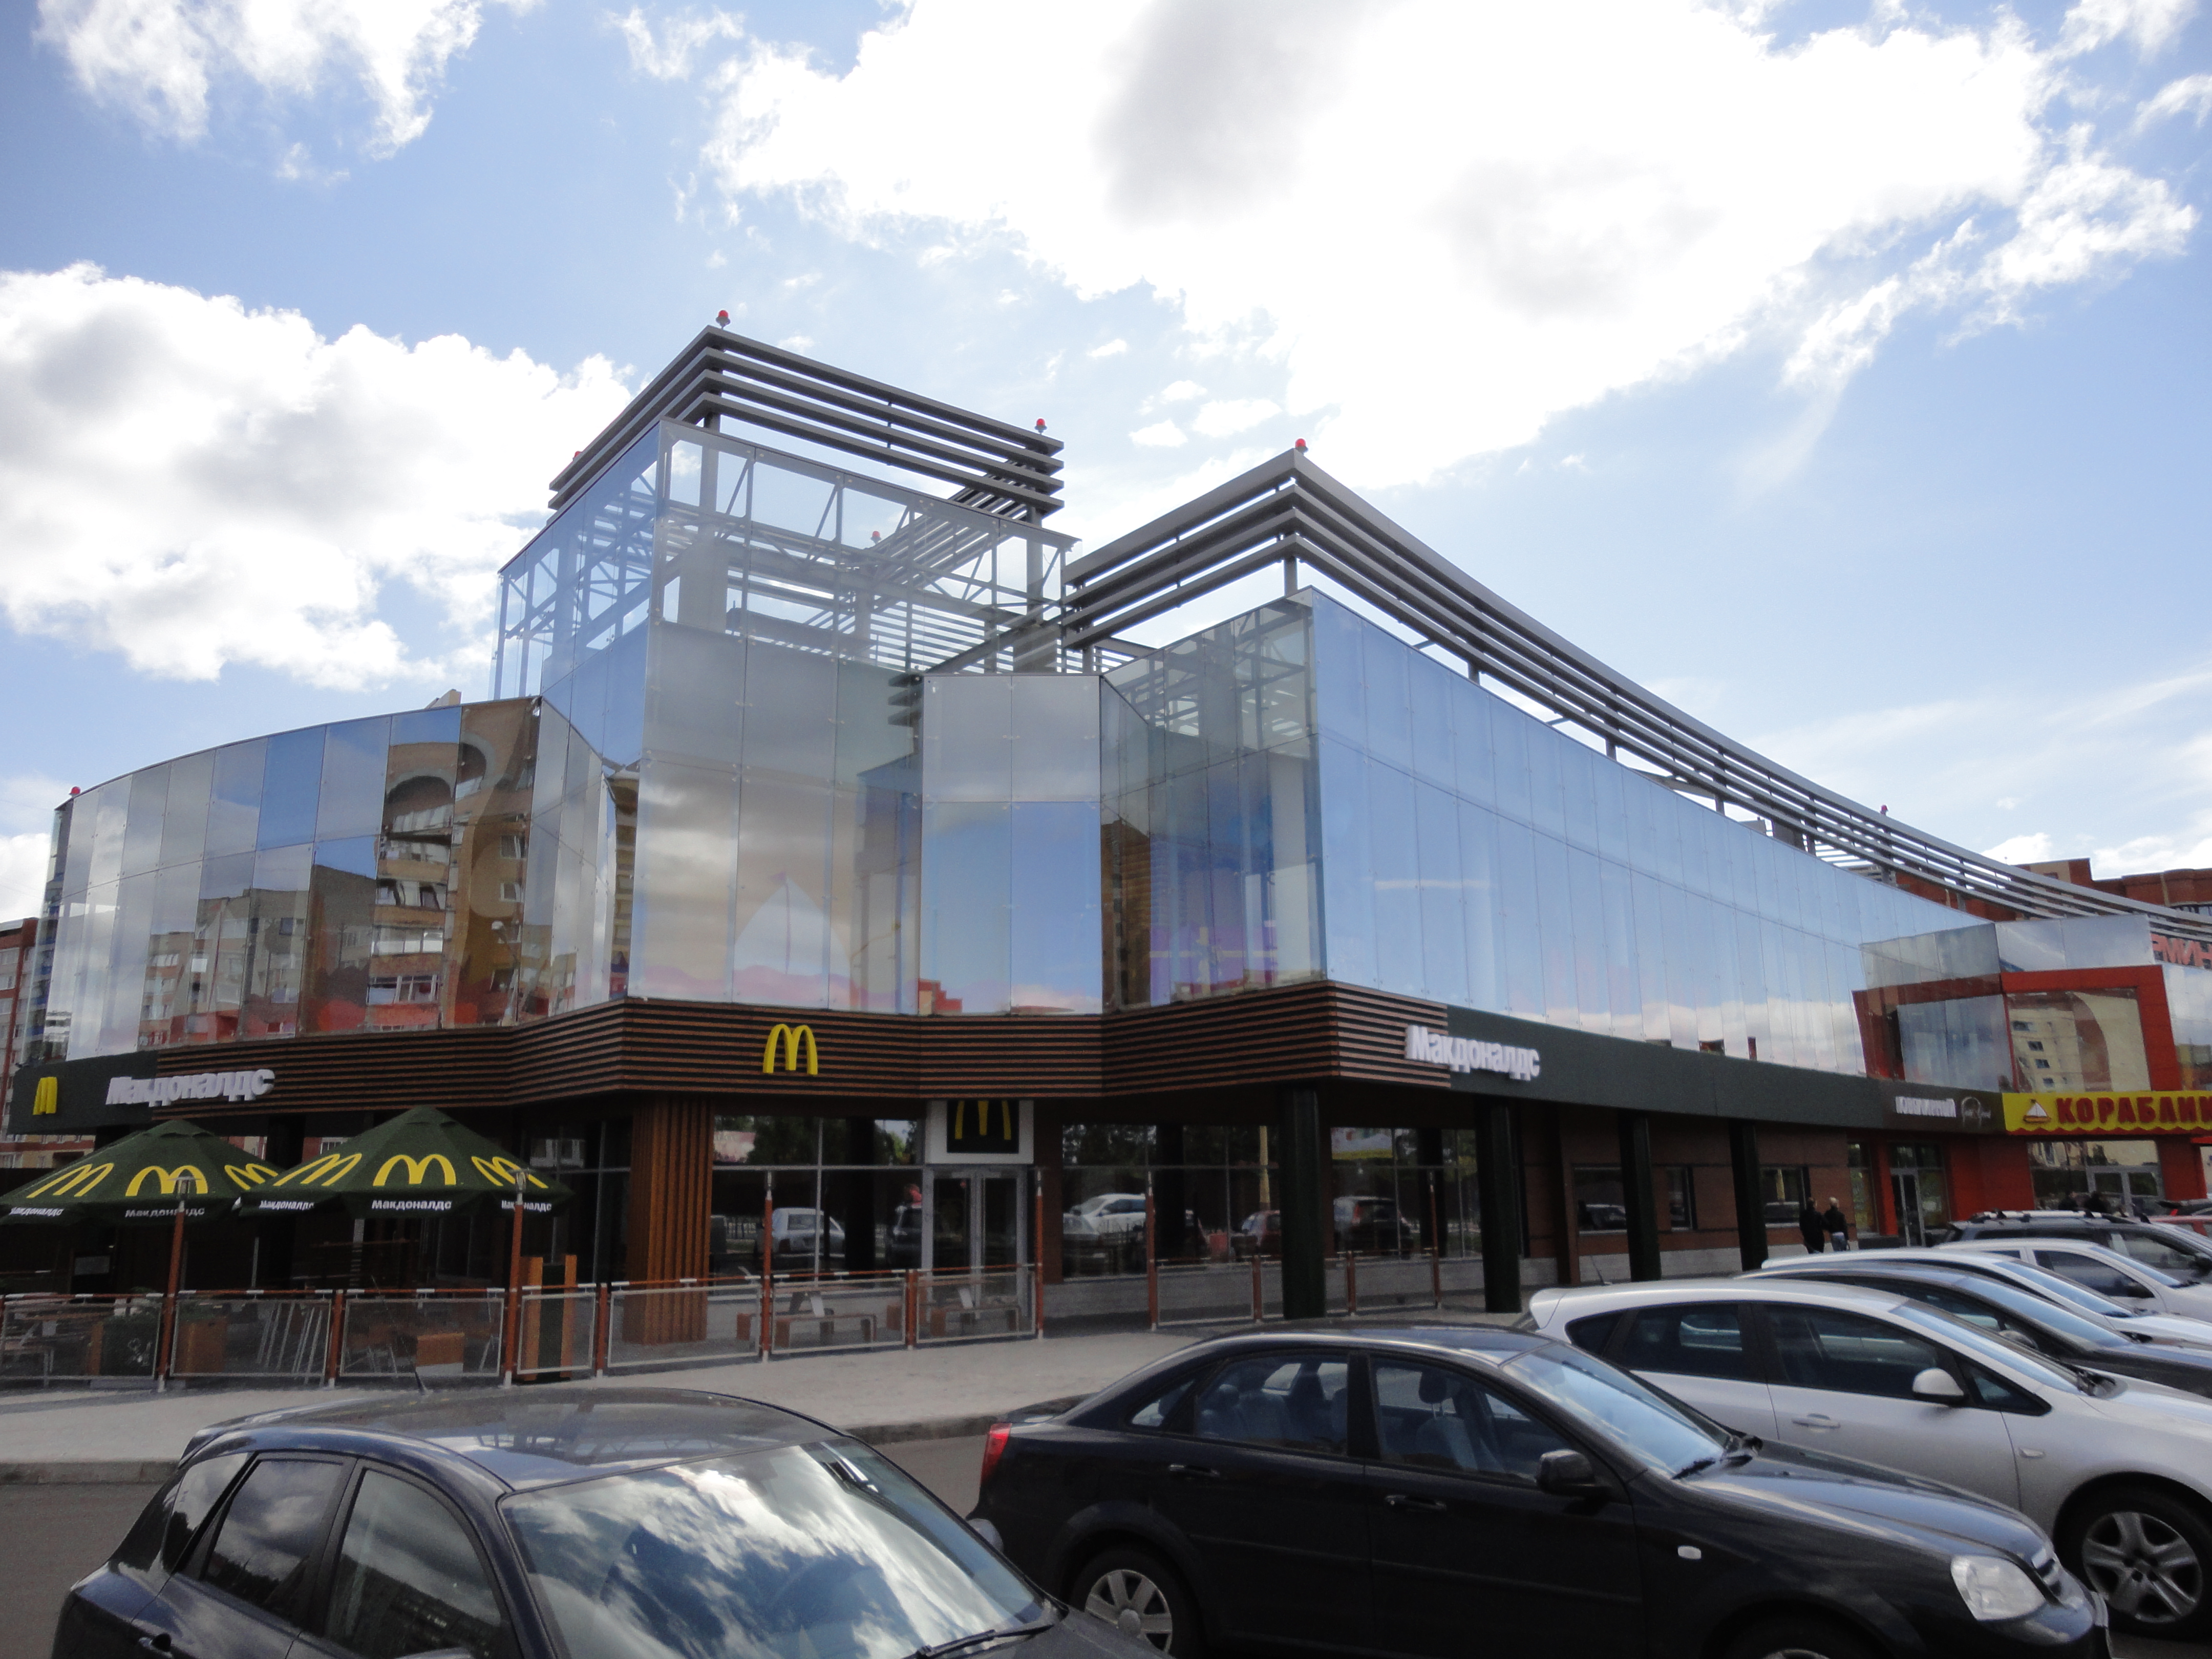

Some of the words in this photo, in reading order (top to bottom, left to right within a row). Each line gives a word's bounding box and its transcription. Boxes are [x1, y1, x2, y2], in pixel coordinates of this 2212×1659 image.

[1405, 1025, 1540, 1081] Макдоналдс
[105, 1069, 275, 1108] Макдоналдс
[371, 1200, 452, 1211] Макдоналдс
[501, 1200, 552, 1212] Макналдс
[124, 1207, 205, 1218] Макдондс
